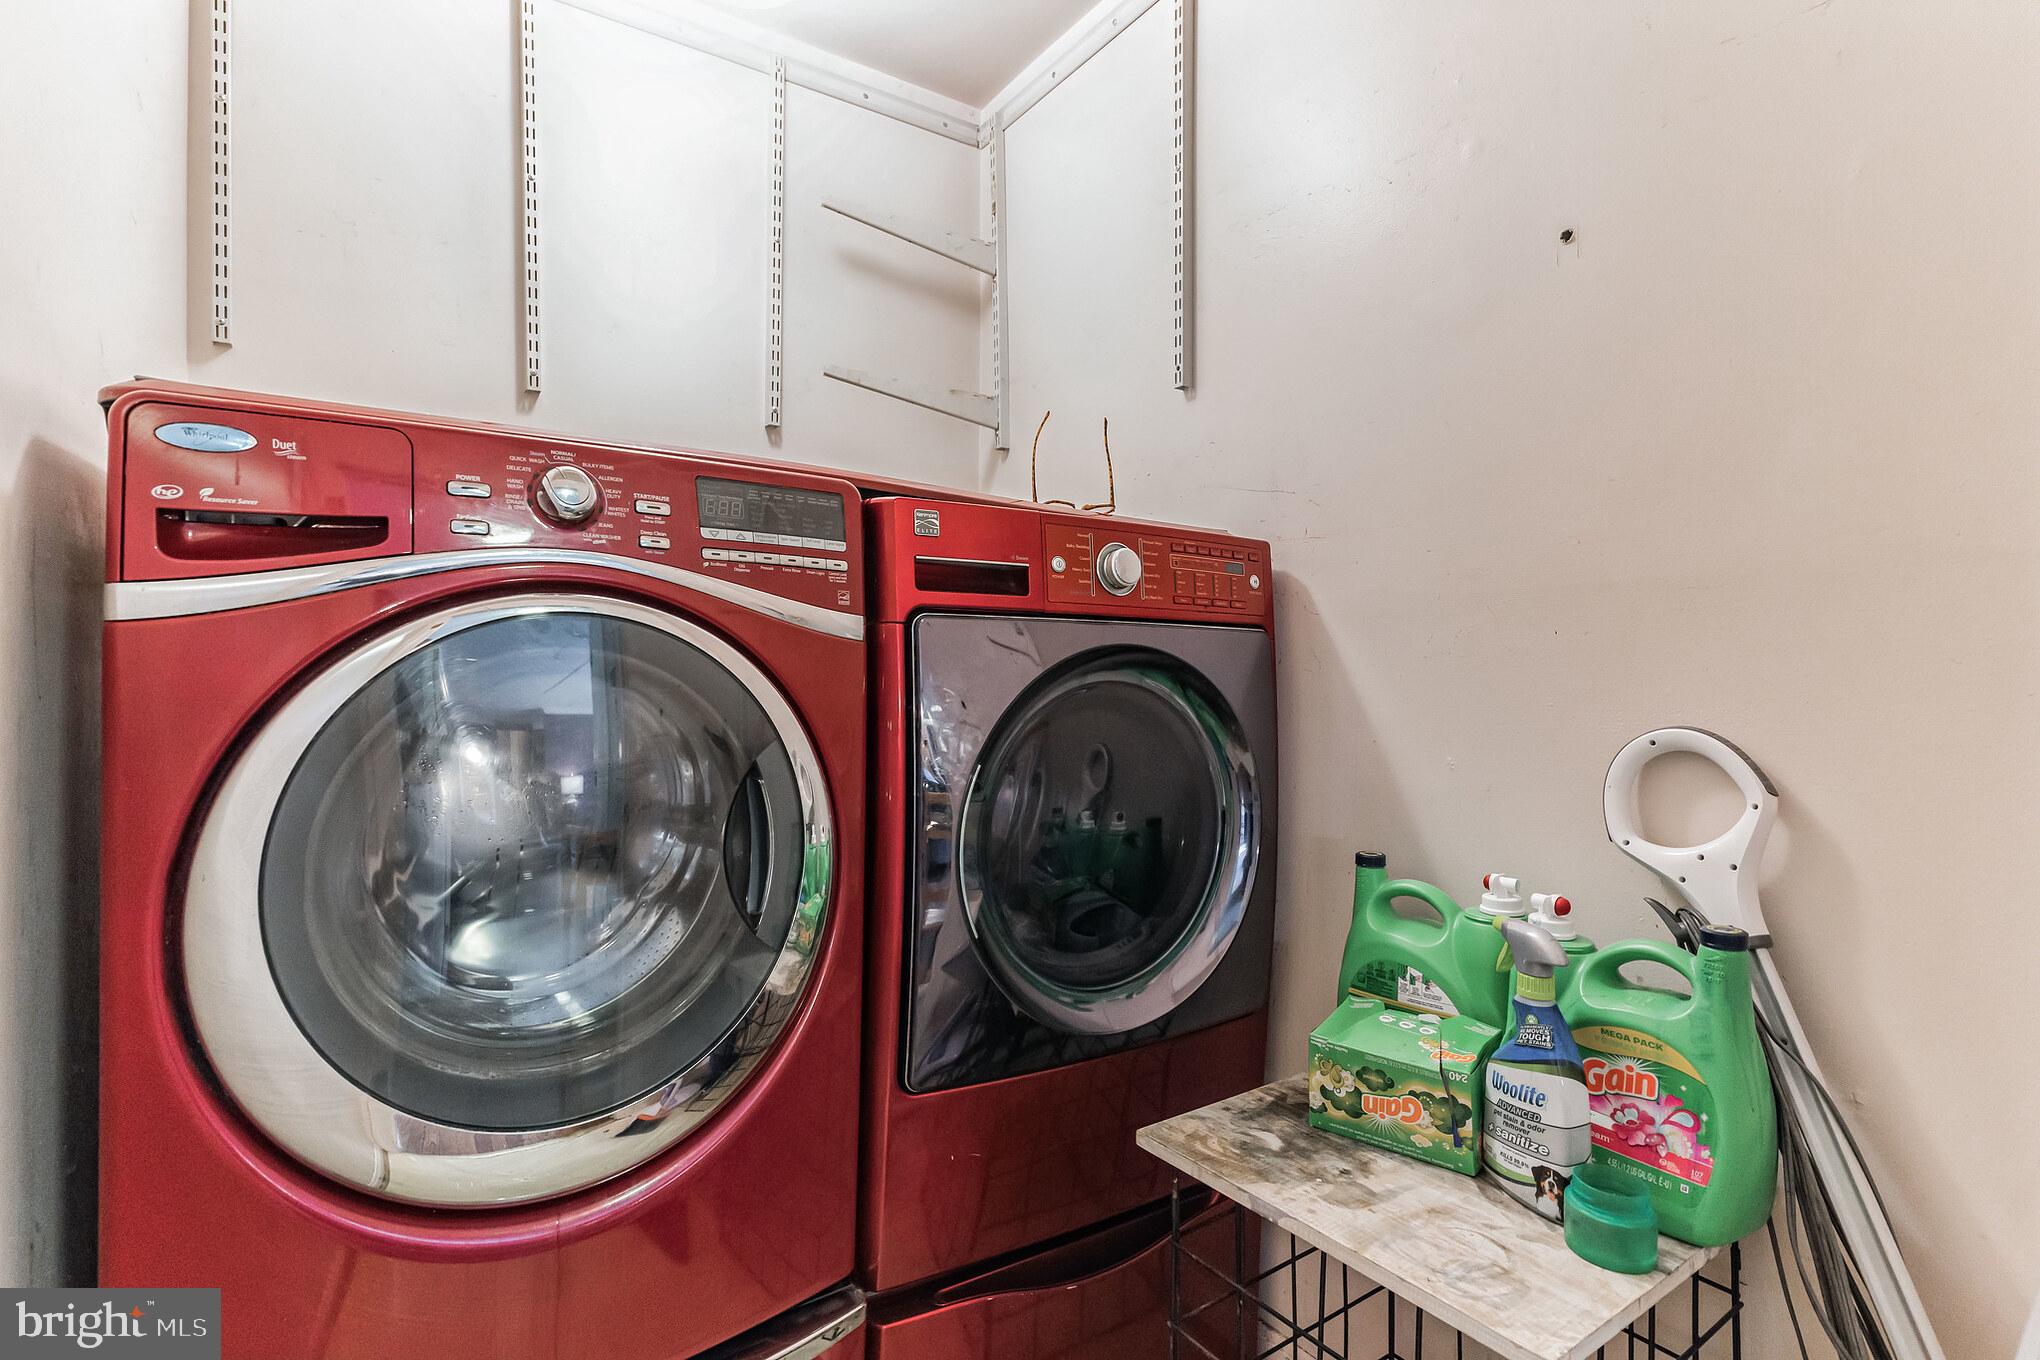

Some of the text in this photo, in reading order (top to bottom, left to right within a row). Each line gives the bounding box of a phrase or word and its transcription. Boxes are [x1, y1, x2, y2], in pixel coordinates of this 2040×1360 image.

[183, 429, 228, 441] Whirlpool
[272, 438, 297, 450] Duet
[506, 464, 532, 472] DELICATE
[456, 474, 480, 482] POWER
[202, 496, 237, 504] Resource
[582, 532, 600, 540] CLEAN
[1600, 1027, 1664, 1051] MEGA PACK
[1448, 1071, 1469, 1084] 240
[1584, 1059, 1657, 1099] Gain
[1492, 1070, 1547, 1107] Woolite
[1362, 1094, 1424, 1124] Gain
[1497, 1101, 1541, 1122] ADVANCED
[1494, 1108, 1502, 1117] pet
[1503, 1113, 1518, 1125] stain
[1526, 1123, 1546, 1134] odor
[1502, 1120, 1530, 1135] remover
[1496, 1126, 1550, 1156] sanitize
[1500, 1151, 1512, 1161] KILLS
